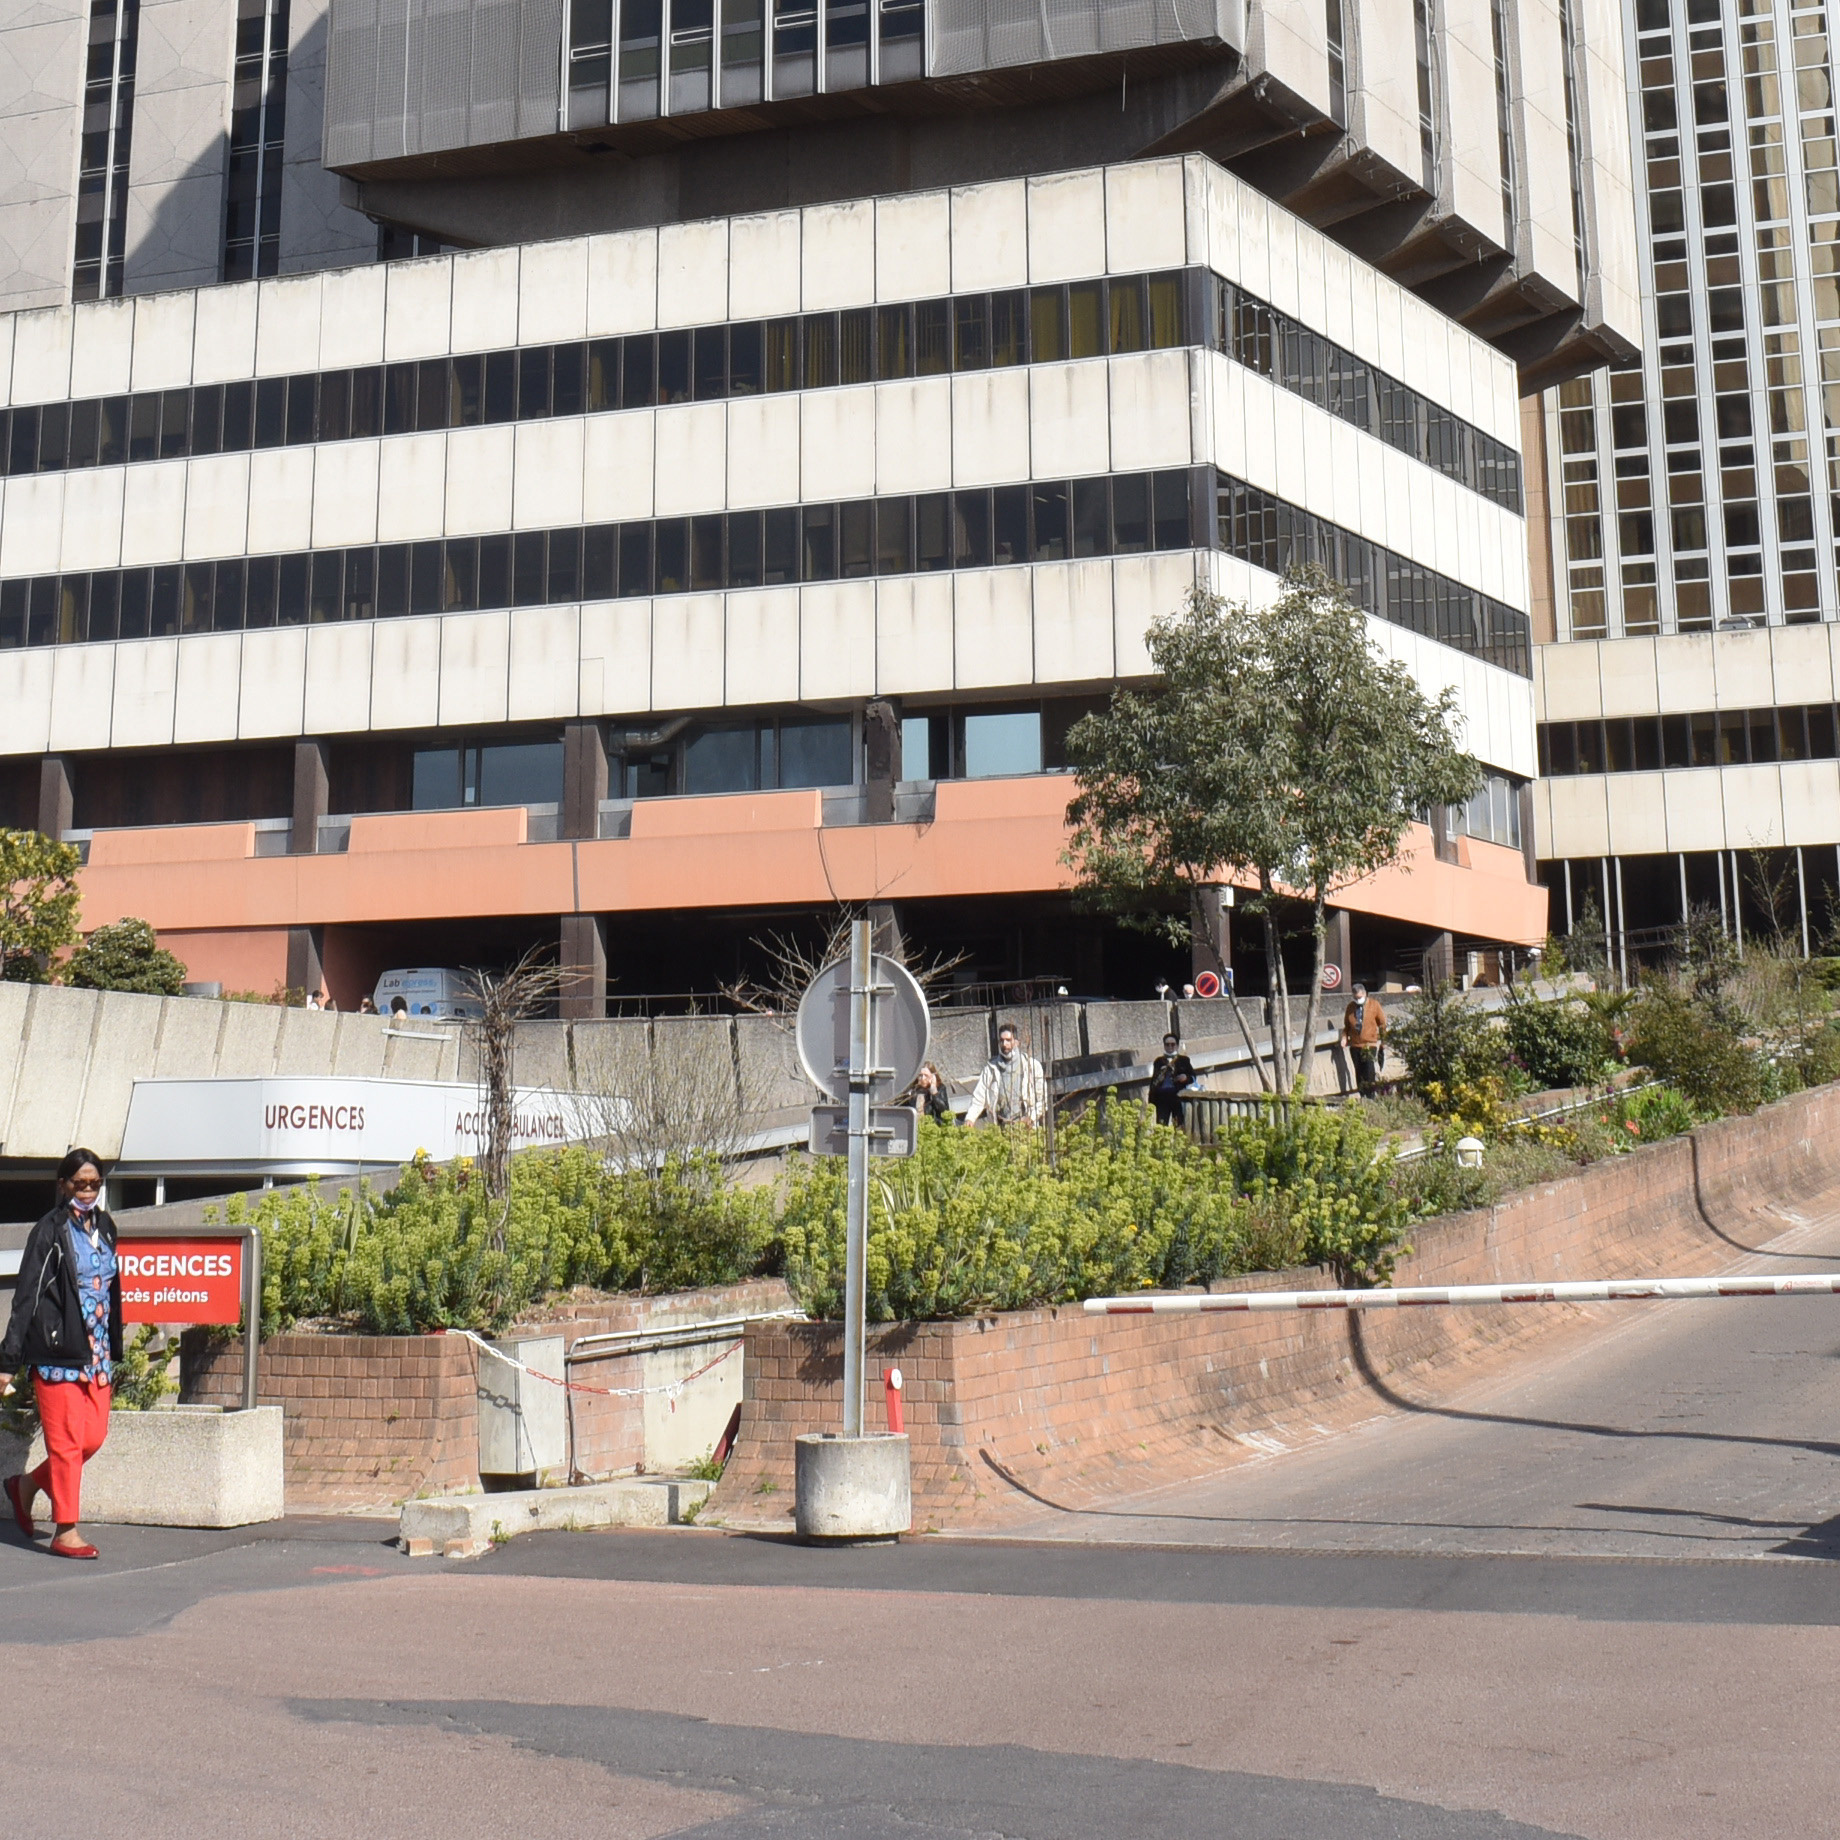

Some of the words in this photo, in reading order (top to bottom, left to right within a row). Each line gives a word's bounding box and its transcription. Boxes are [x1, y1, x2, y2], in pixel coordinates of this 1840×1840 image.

[264, 1105, 365, 1130] URGENCES
[121, 1287, 150, 1303] ccès
[153, 1286, 209, 1306] piétons
